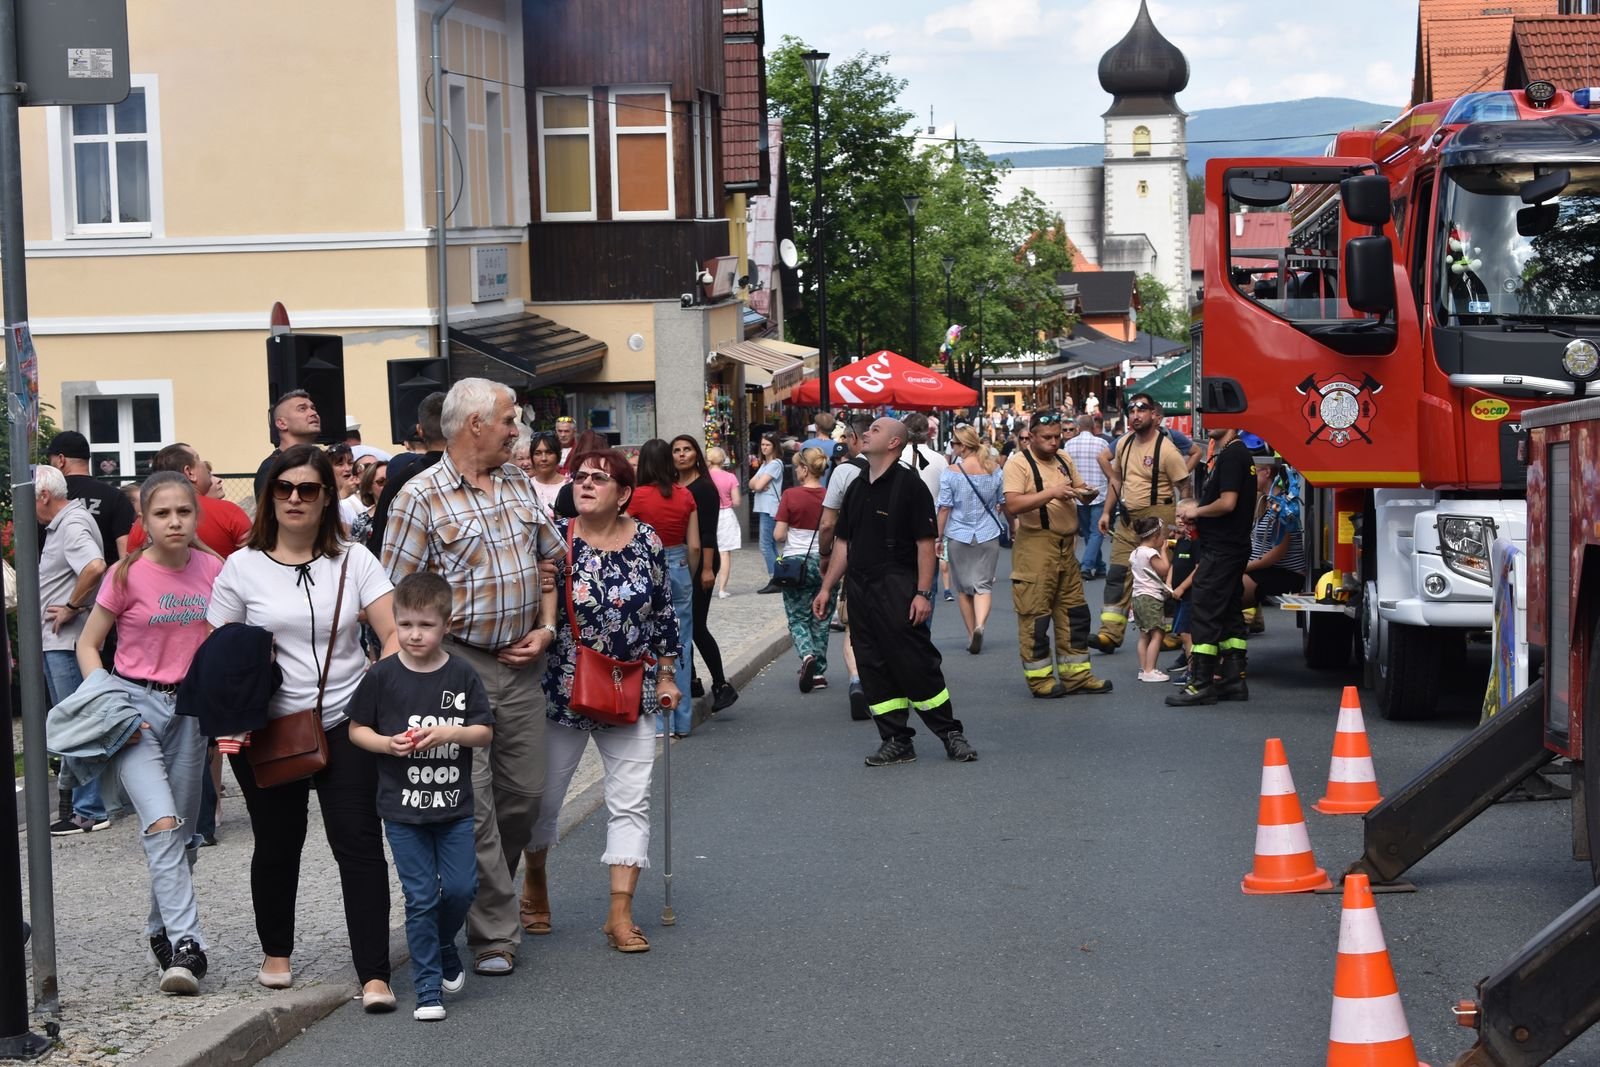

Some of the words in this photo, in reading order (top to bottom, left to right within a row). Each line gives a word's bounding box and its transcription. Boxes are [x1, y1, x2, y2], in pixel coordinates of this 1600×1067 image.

[1159, 401, 1178, 409] ZEC
[1509, 423, 1527, 433] V
[1250, 465, 1257, 475] S
[158, 592, 180, 609] Nie
[408, 742, 460, 760] HING
[407, 766, 460, 784] GOOD
[401, 789, 460, 809] TODAY
